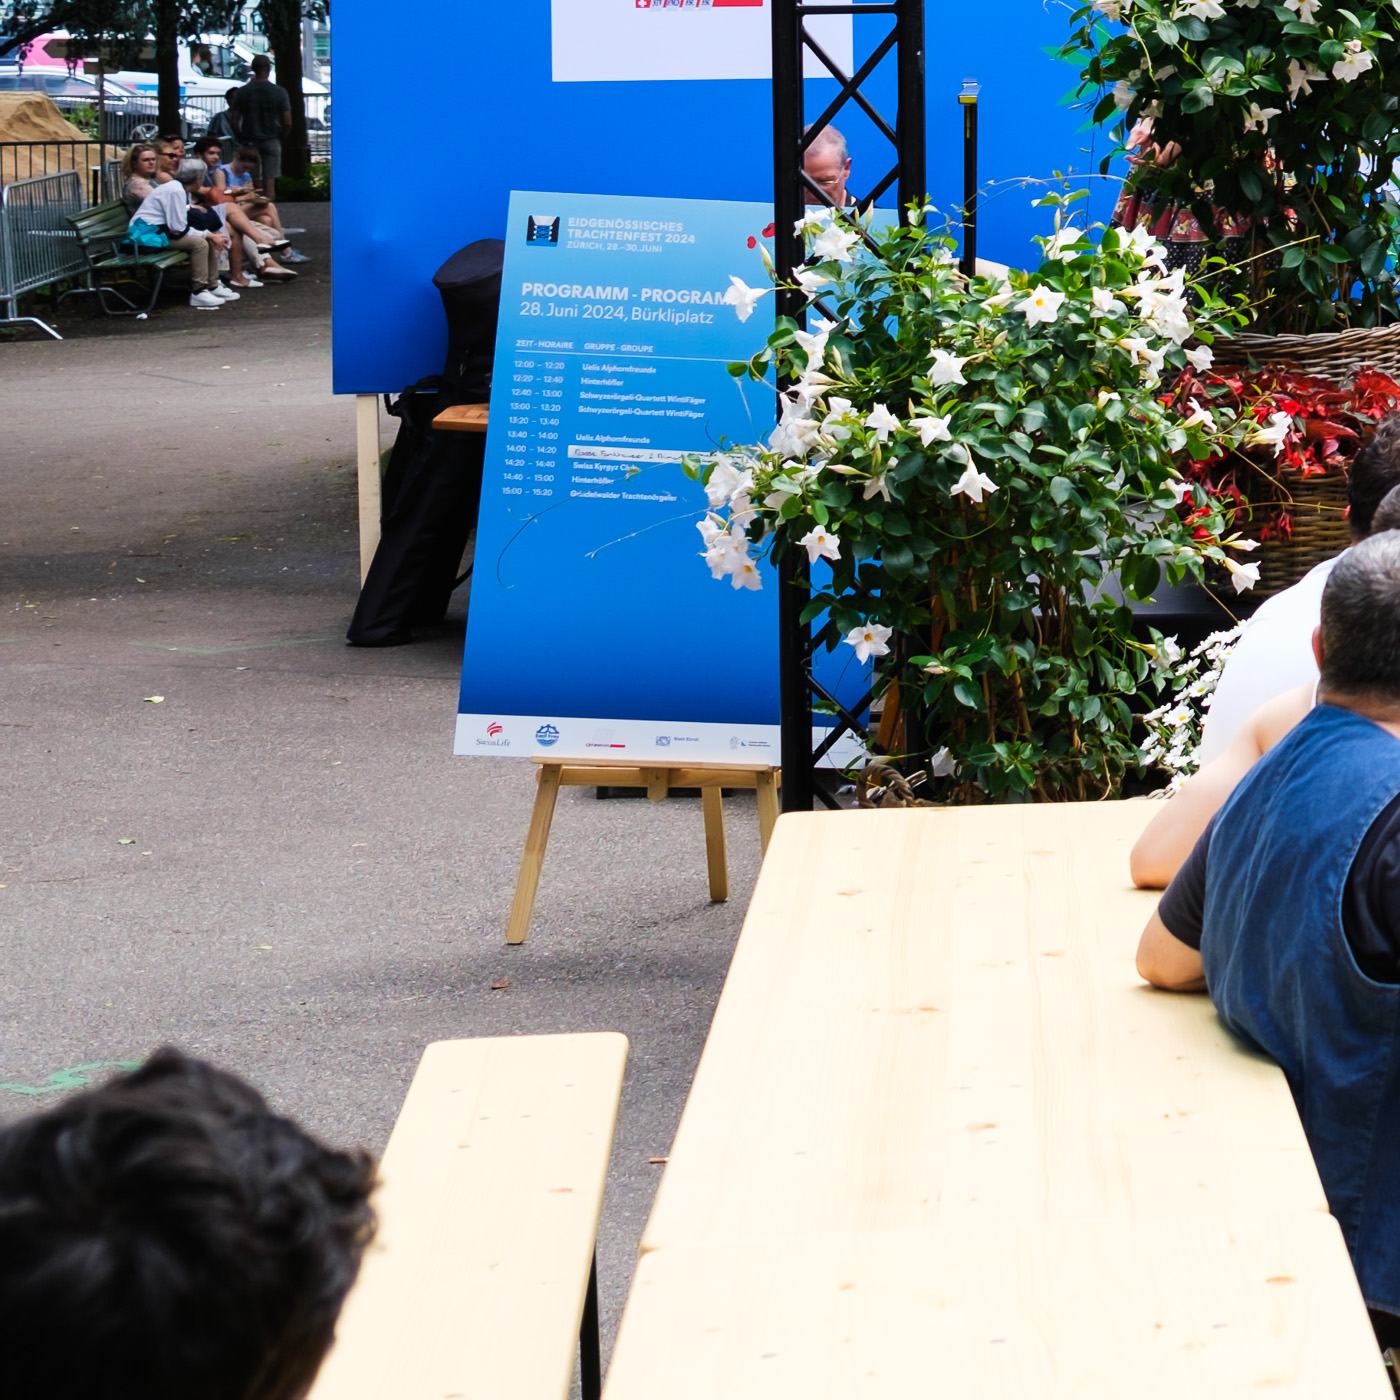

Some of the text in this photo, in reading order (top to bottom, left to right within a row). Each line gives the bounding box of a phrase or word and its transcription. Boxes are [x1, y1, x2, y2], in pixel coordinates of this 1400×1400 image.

[568, 217, 684, 232] EIDGENÖSSISCHES
[567, 229, 696, 244] TRACHTENFEST 2024
[522, 282, 629, 300] PROGRAMM
[582, 304, 628, 322] 2024,
[631, 307, 714, 326] Bürkliplatz
